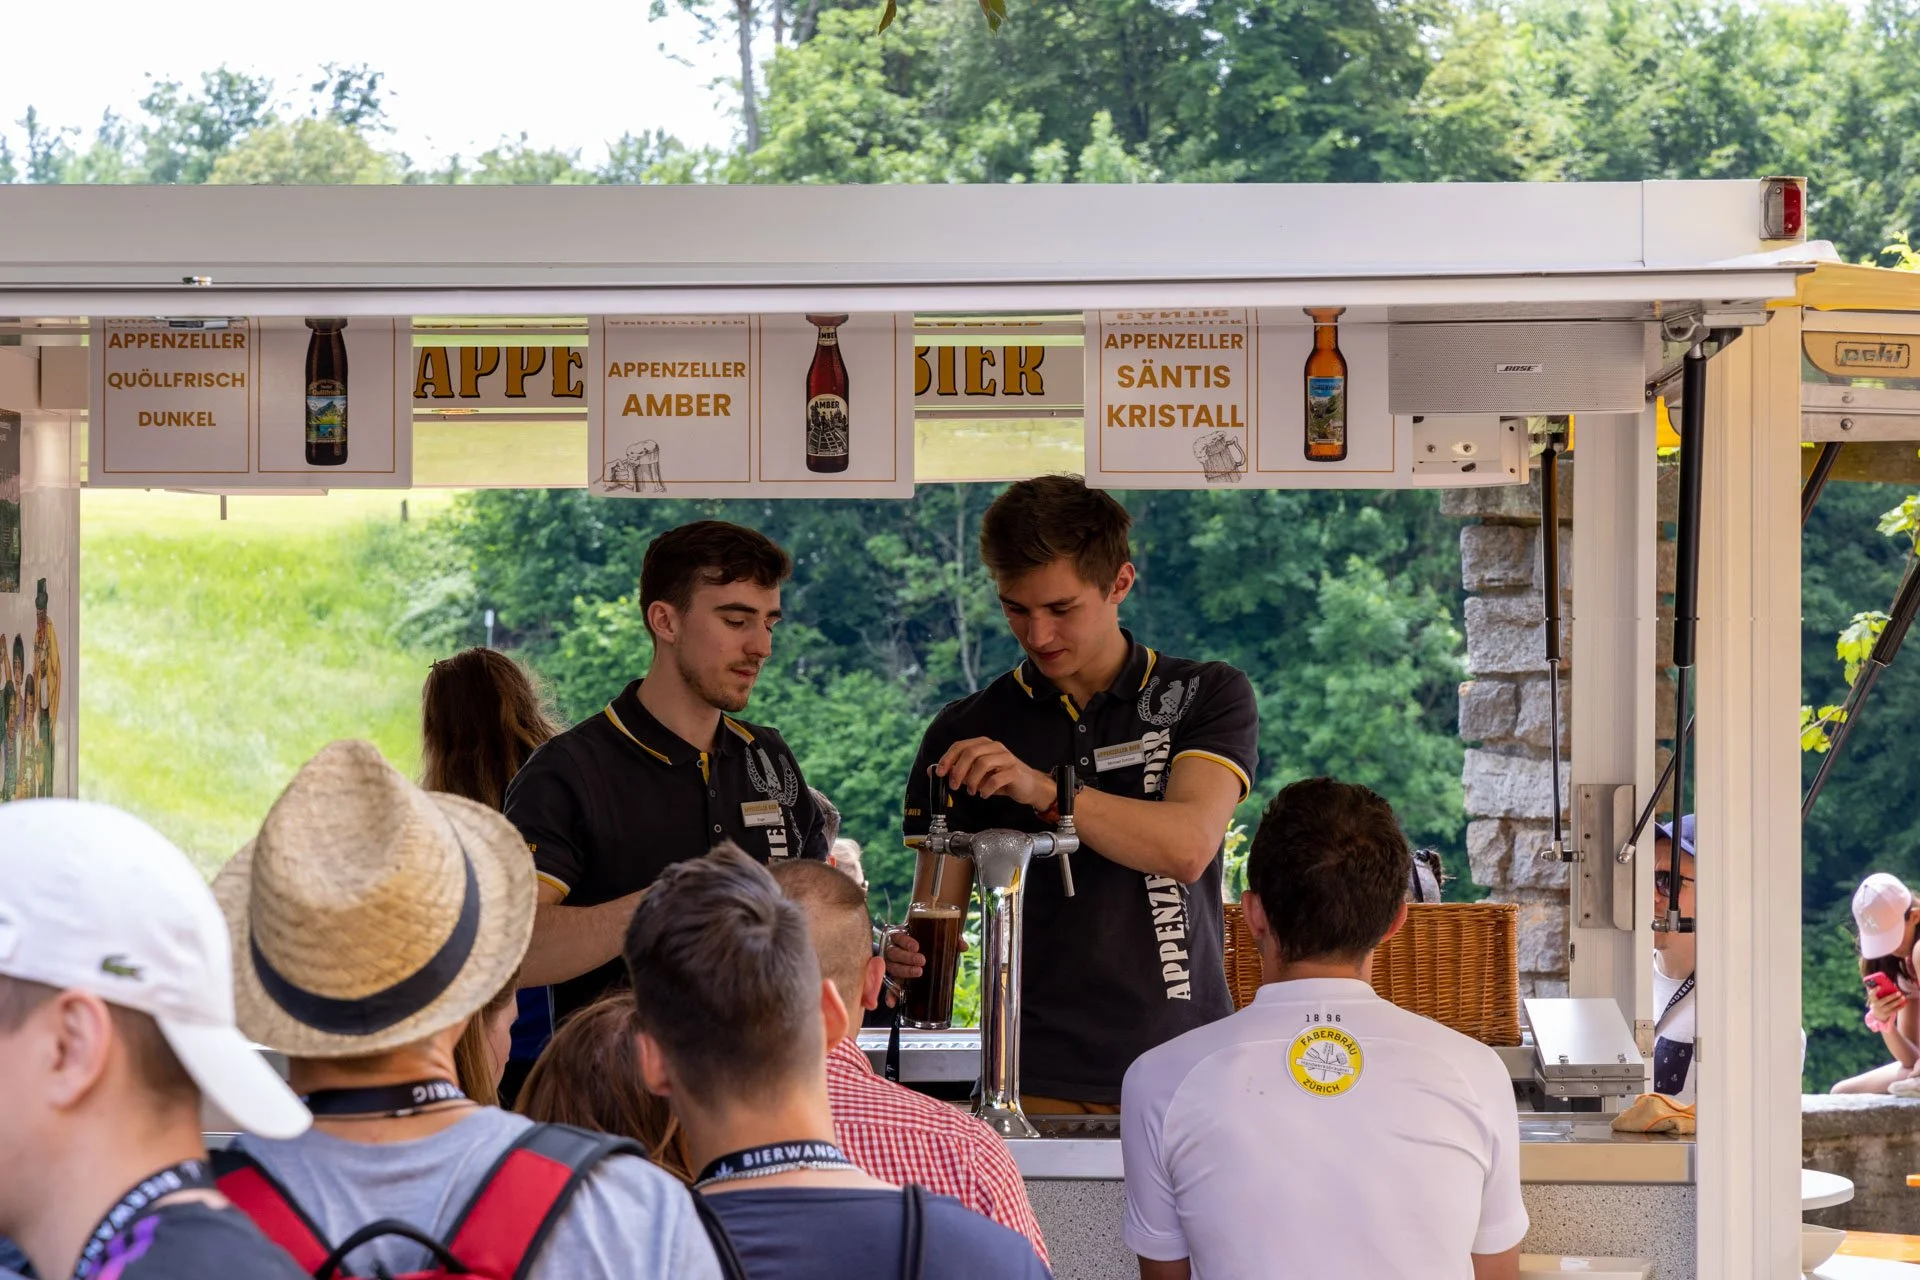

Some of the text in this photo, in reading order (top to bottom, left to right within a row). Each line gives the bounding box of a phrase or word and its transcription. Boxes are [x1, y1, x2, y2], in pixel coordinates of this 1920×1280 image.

[108, 333, 246, 349] APPENZELLER
[1104, 333, 1243, 349] APPENZELLER
[608, 361, 746, 378] APPENZELLER
[1117, 359, 1231, 388] SÄNTIS
[107, 369, 246, 389] QUÖLLFRISCH
[622, 393, 732, 417] AMBER
[815, 400, 840, 409] AMBER
[138, 411, 217, 427] DUNKEL
[1107, 403, 1245, 428] KRISTALL
[1141, 728, 1171, 793] BIER
[1301, 1031, 1357, 1056] FABERBRÄU
[1303, 1078, 1340, 1093] ZÜRICH
